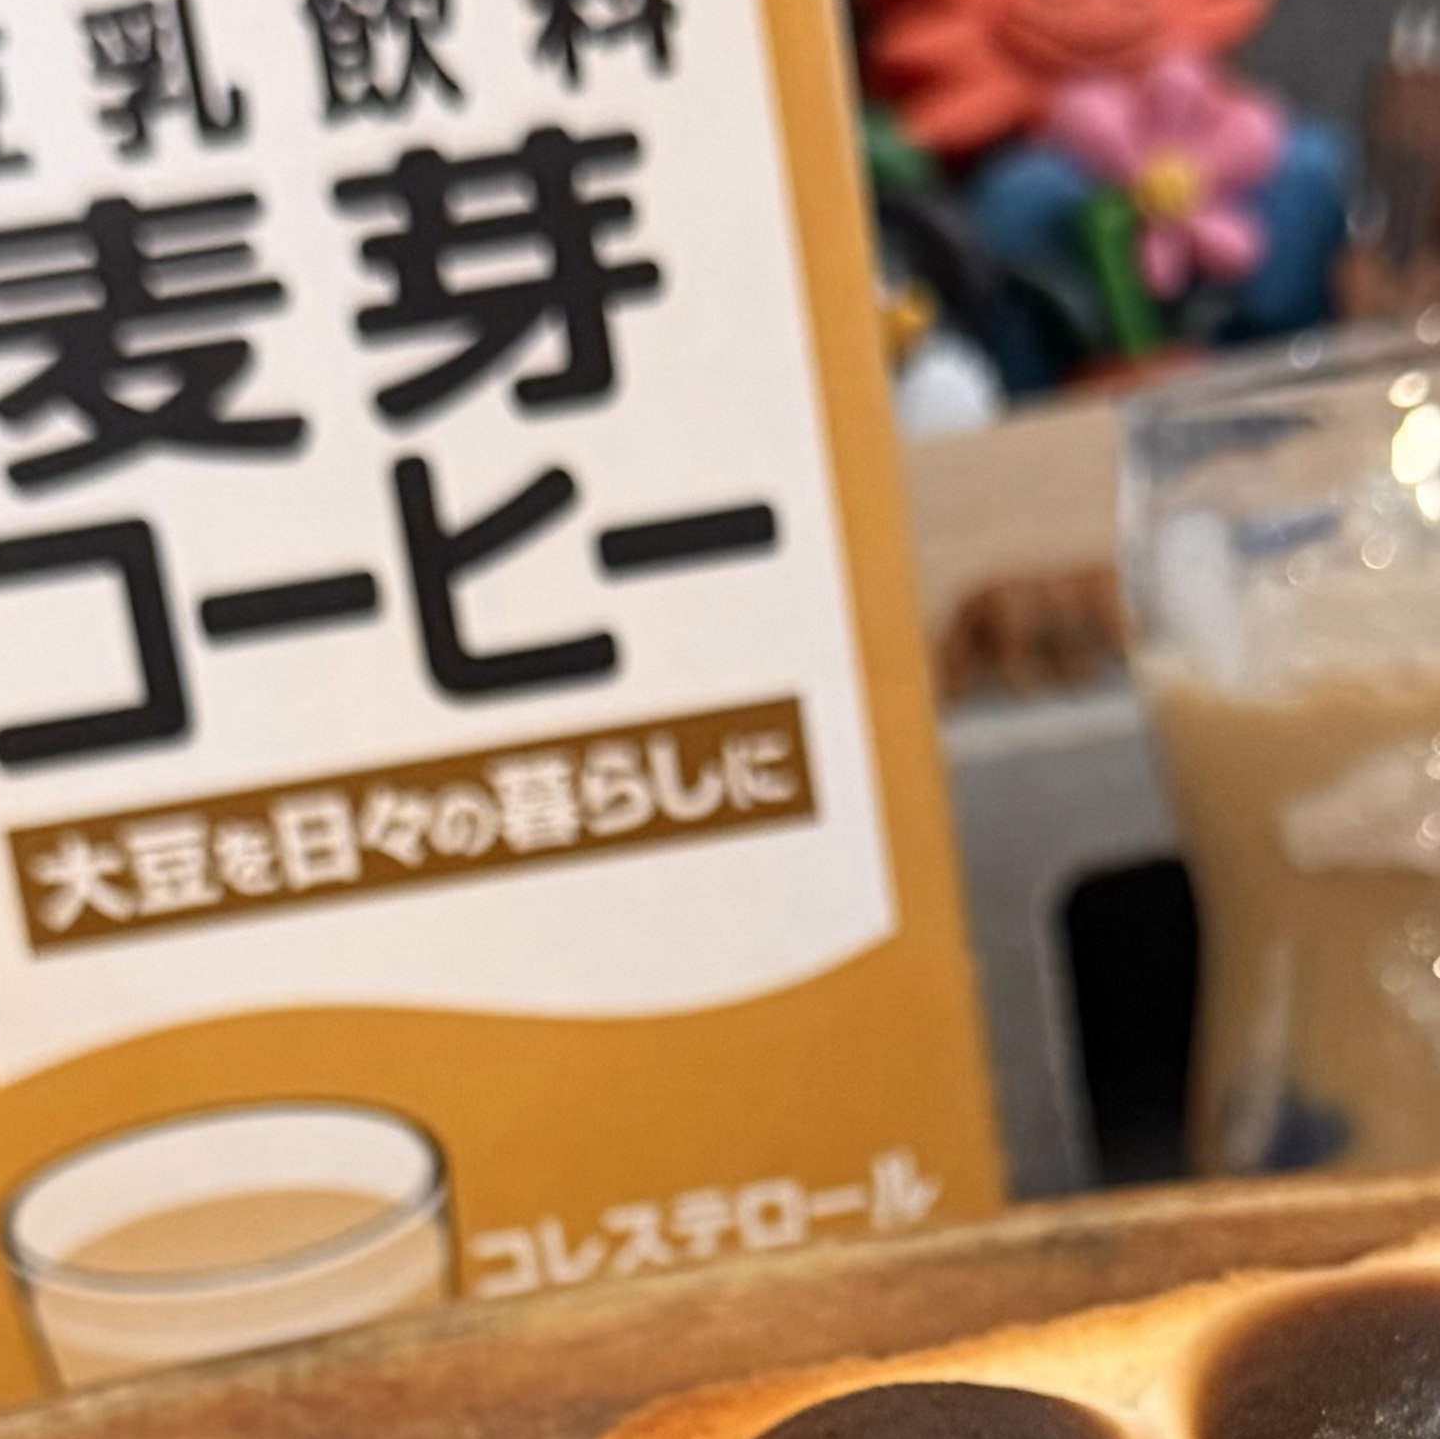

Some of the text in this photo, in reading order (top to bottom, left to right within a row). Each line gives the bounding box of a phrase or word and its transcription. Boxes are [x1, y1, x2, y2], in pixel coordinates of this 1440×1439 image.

[32, 729, 802, 934] 大豆を日々の暮らしに
[468, 1150, 942, 1298] コレステロール
